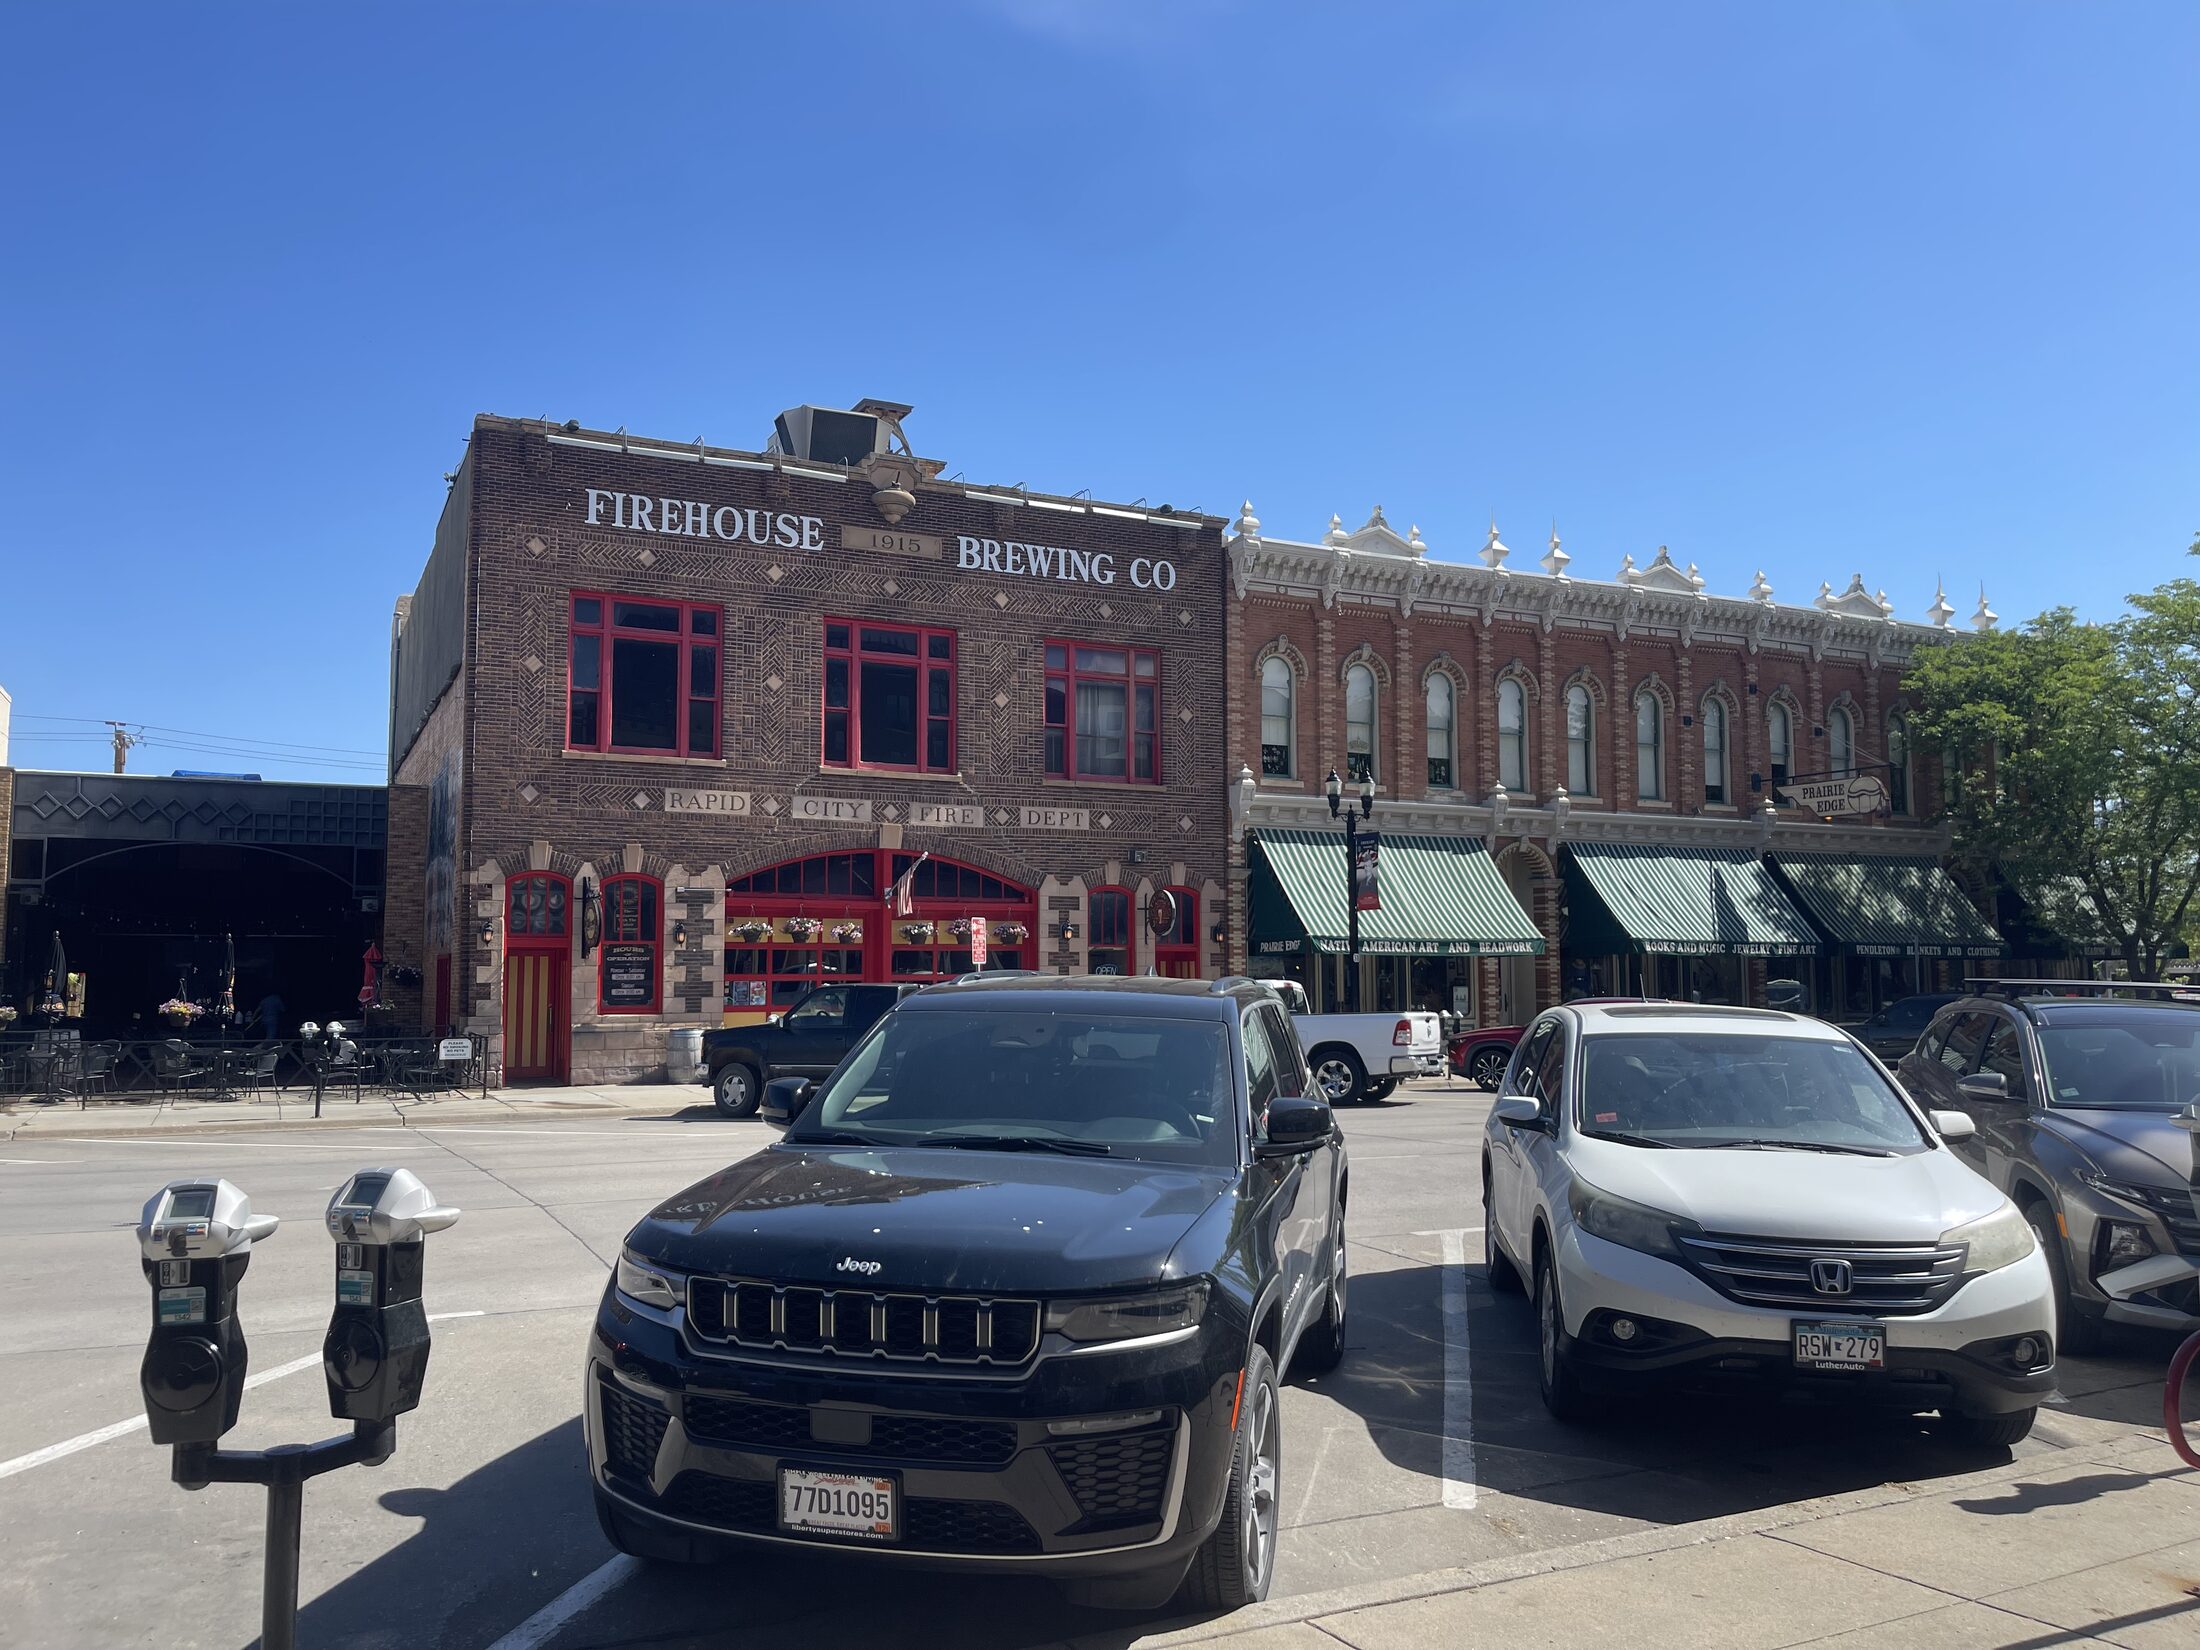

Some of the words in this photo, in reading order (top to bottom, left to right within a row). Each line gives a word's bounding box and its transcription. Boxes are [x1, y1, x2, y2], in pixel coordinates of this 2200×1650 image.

[584, 488, 825, 551] FIREHOUSE
[871, 533, 922, 552] 1915
[956, 535, 1117, 585] BREWING
[1129, 557, 1177, 591] CO
[1802, 783, 1845, 799] PRAIRIE
[669, 792, 746, 811] RAPID
[803, 799, 865, 818] CITY
[919, 806, 974, 824] FIRE
[1027, 810, 1084, 827] DEPT
[1817, 799, 1845, 812] EDGE
[1260, 942, 1285, 953] PRAIRIE
[1319, 939, 1350, 952] NATIV
[1361, 940, 1416, 953] AMERICAN
[1418, 941, 1439, 953] ART
[1448, 942, 1470, 953] AND
[1479, 941, 1534, 953] BEADWORK
[1645, 941, 1676, 952] BOOKS
[1677, 942, 1697, 953] AND
[1698, 943, 1726, 954] MUSIC
[1731, 943, 1772, 954] JEWELRY
[1778, 944, 1798, 955] FINE
[1799, 945, 1817, 955] ART
[1906, 946, 1942, 956] BLNKETS
[1947, 947, 1962, 956] AND
[1967, 947, 2001, 956] CLOTHING
[1096, 966, 1117, 976] OPEN
[836, 1257, 881, 1276] Jeep
[1799, 1334, 1832, 1357] RSW
[1846, 1336, 1879, 1359] 279
[1815, 1360, 1865, 1371] LutherAuto
[789, 1485, 890, 1521] 77D1095
[791, 1524, 884, 1539] libertysuperstores.com
